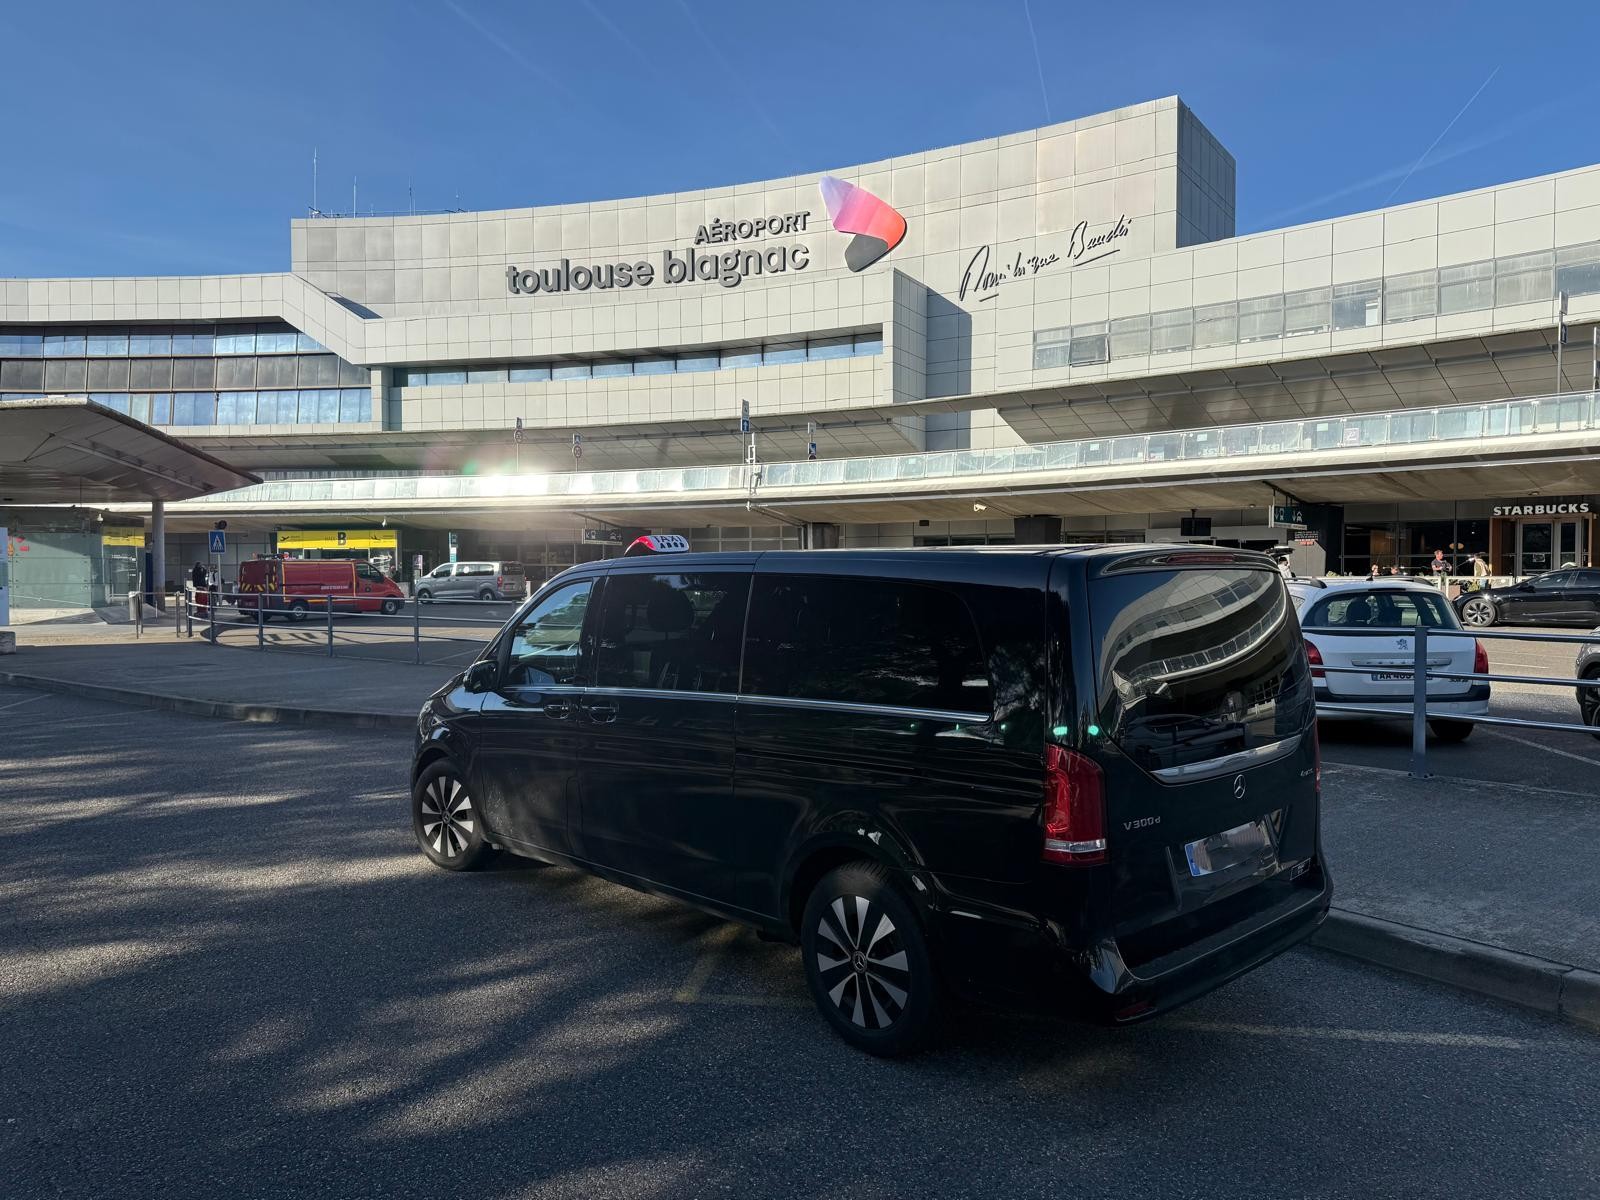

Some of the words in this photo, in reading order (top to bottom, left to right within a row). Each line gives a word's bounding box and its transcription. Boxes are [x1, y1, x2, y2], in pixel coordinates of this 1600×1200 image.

[694, 210, 810, 245] AÉROPORT
[505, 258, 655, 294] toulouse
[662, 243, 810, 287] blagnac
[1493, 503, 1590, 516] STARBUCKS
[337, 531, 348, 546] B
